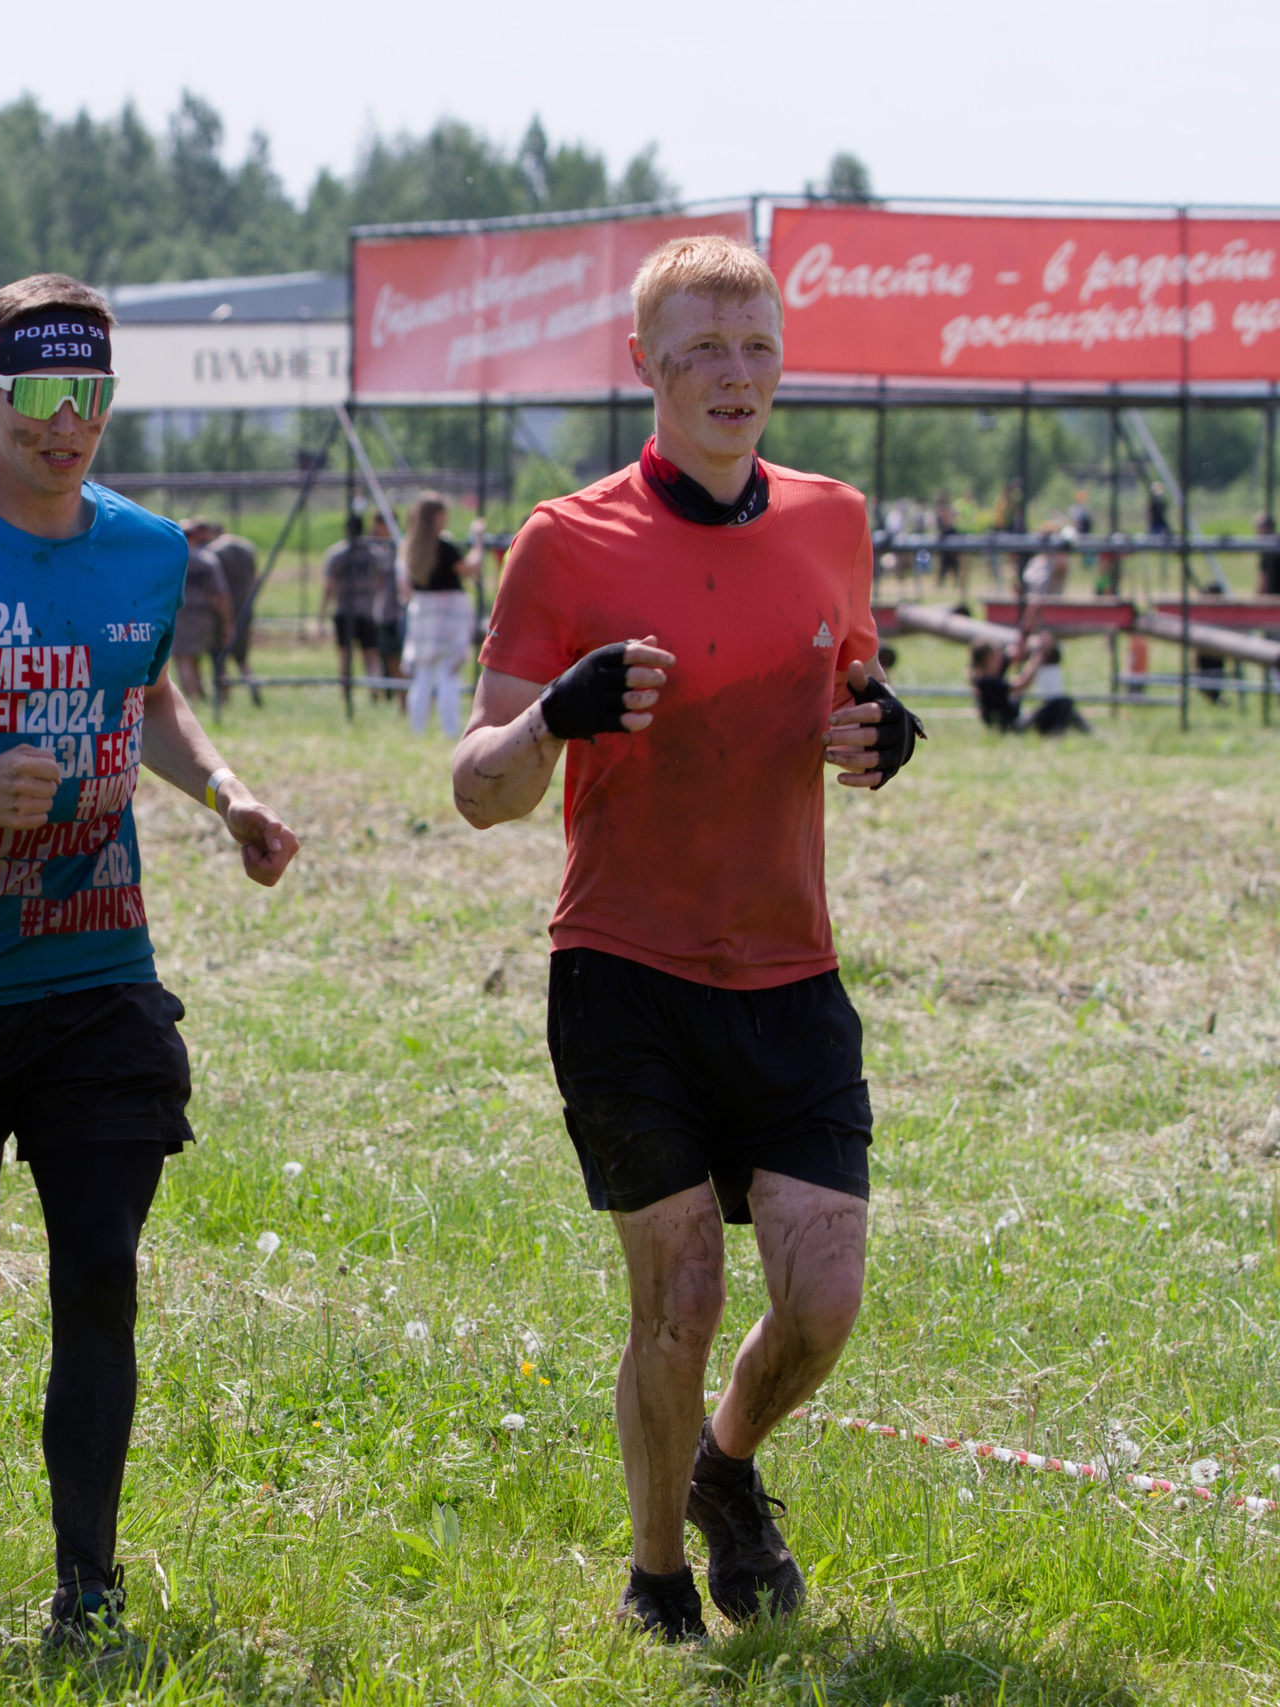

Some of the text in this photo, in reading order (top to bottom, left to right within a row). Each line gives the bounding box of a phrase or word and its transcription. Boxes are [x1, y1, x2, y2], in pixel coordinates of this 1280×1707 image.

[784, 242, 974, 309] Счастье
[1078, 237, 1276, 305] радости
[14, 323, 105, 341] РОДЕО 59
[41, 342, 92, 358] 2530
